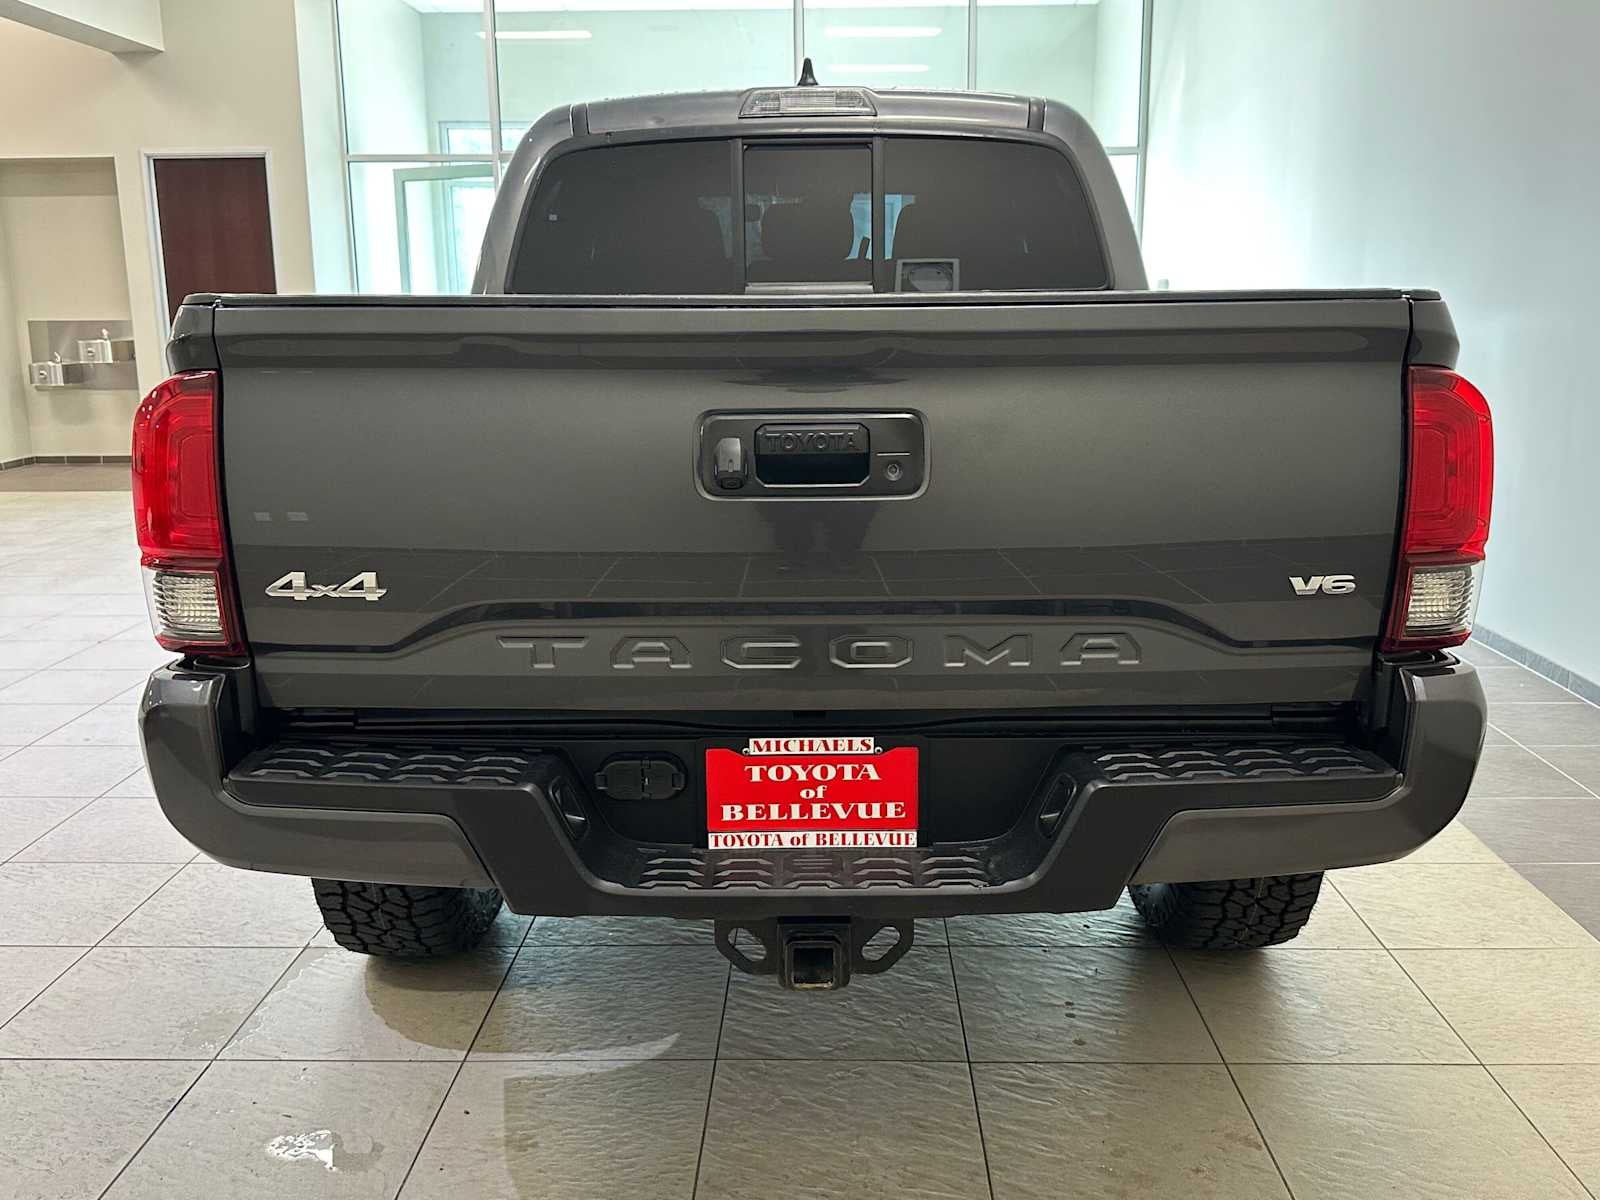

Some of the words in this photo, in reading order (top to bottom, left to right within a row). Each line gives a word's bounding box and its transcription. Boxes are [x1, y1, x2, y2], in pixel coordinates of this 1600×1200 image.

[764, 432, 860, 450] TOYOTA
[265, 571, 387, 600] 4x4
[1289, 575, 1356, 595] V6
[496, 633, 1142, 669] TACOMA
[752, 738, 873, 752] MICHAELS
[744, 764, 881, 782] TOYOTA
[799, 785, 827, 799] of
[720, 801, 906, 821] BELLEVUE
[710, 834, 784, 847] TOYOTA
[790, 833, 810, 846] of
[815, 832, 916, 846] BELLEVUE
